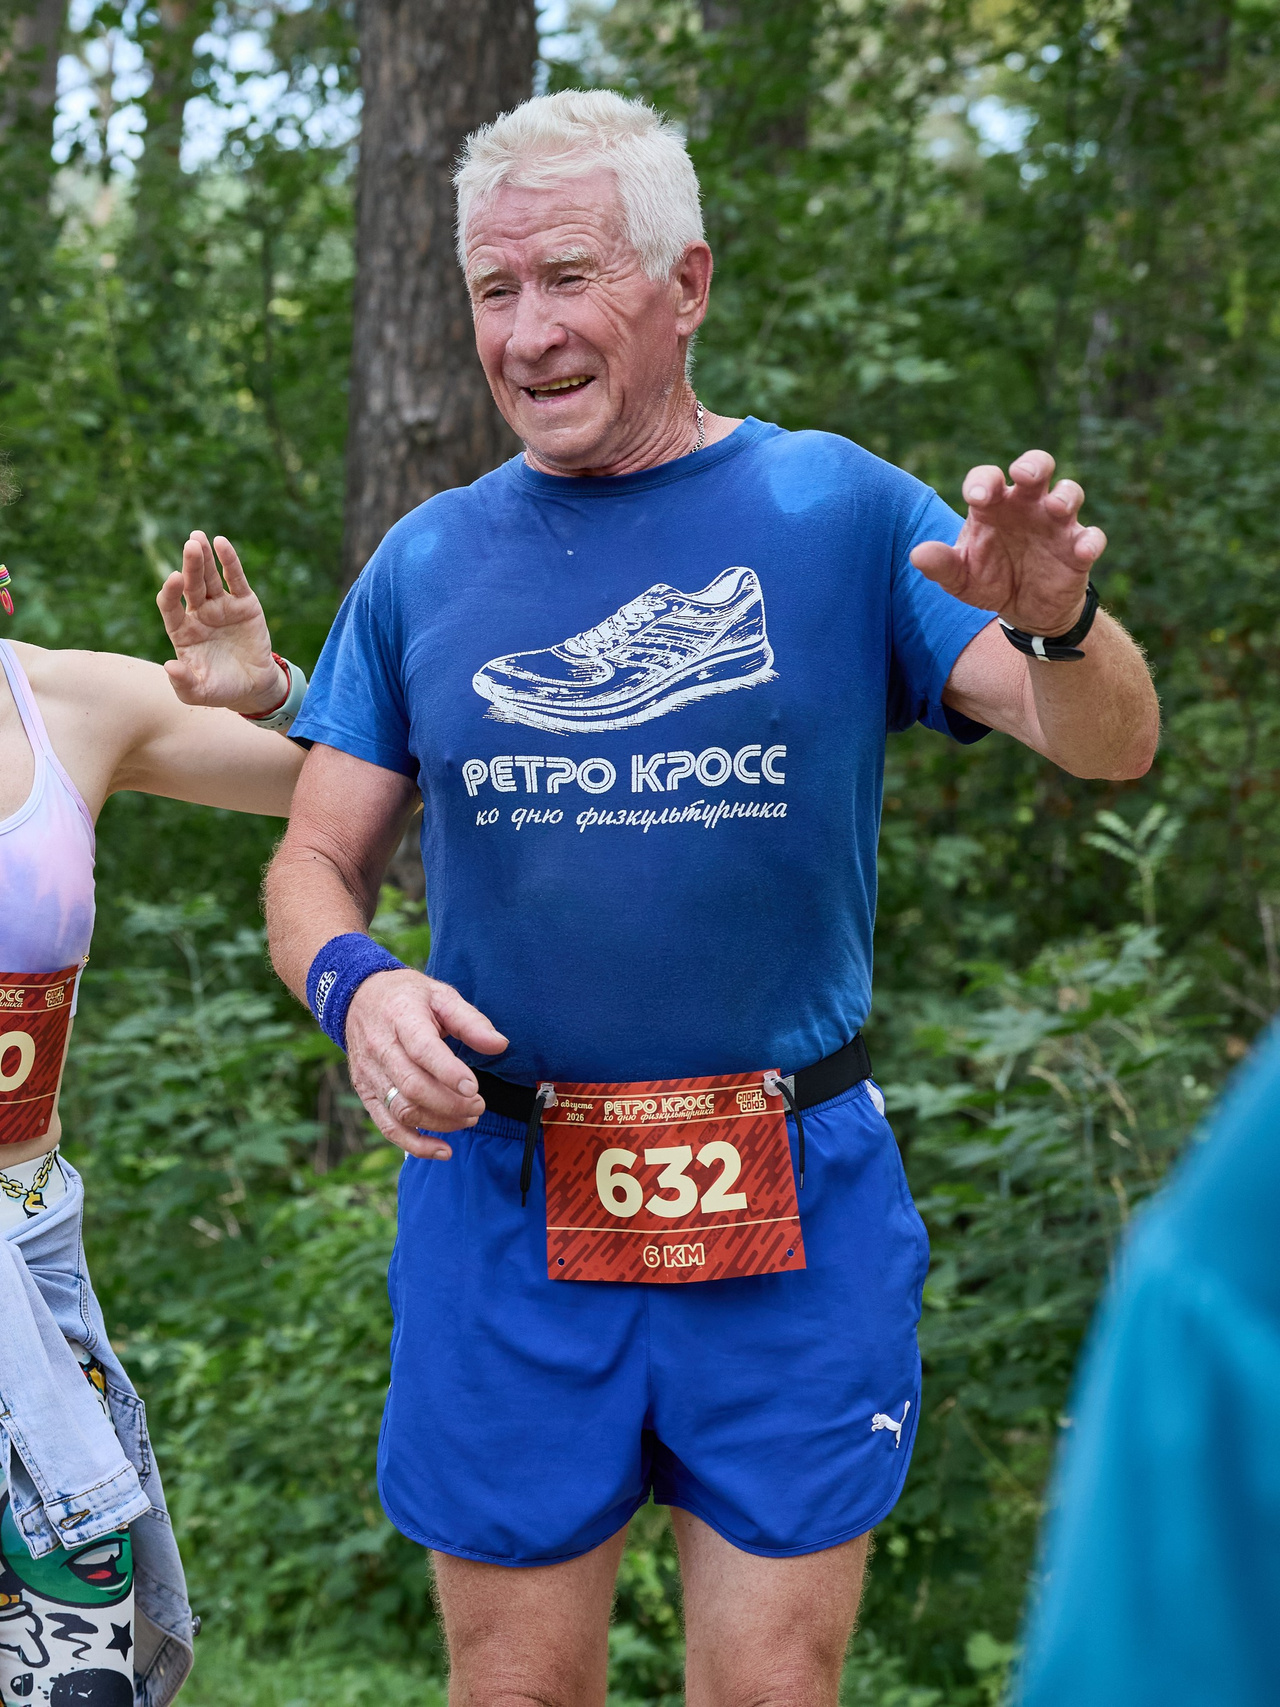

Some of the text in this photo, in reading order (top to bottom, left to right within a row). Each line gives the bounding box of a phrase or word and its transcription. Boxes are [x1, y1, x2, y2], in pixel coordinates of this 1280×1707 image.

[462, 744, 787, 797] РЕТРО КРОСС
[475, 799, 788, 833] ко дню физкультурника
[560, 1099, 594, 1111] августа
[604, 1094, 715, 1116] РЕТРО КРОСС
[736, 1089, 763, 1103] СПОРТ
[740, 1099, 767, 1113] СОЮЗ
[566, 1112, 585, 1122] 2026
[603, 1108, 715, 1124] ко дню физкультурника
[595, 1140, 748, 1219] 632
[643, 1246, 660, 1268] 6
